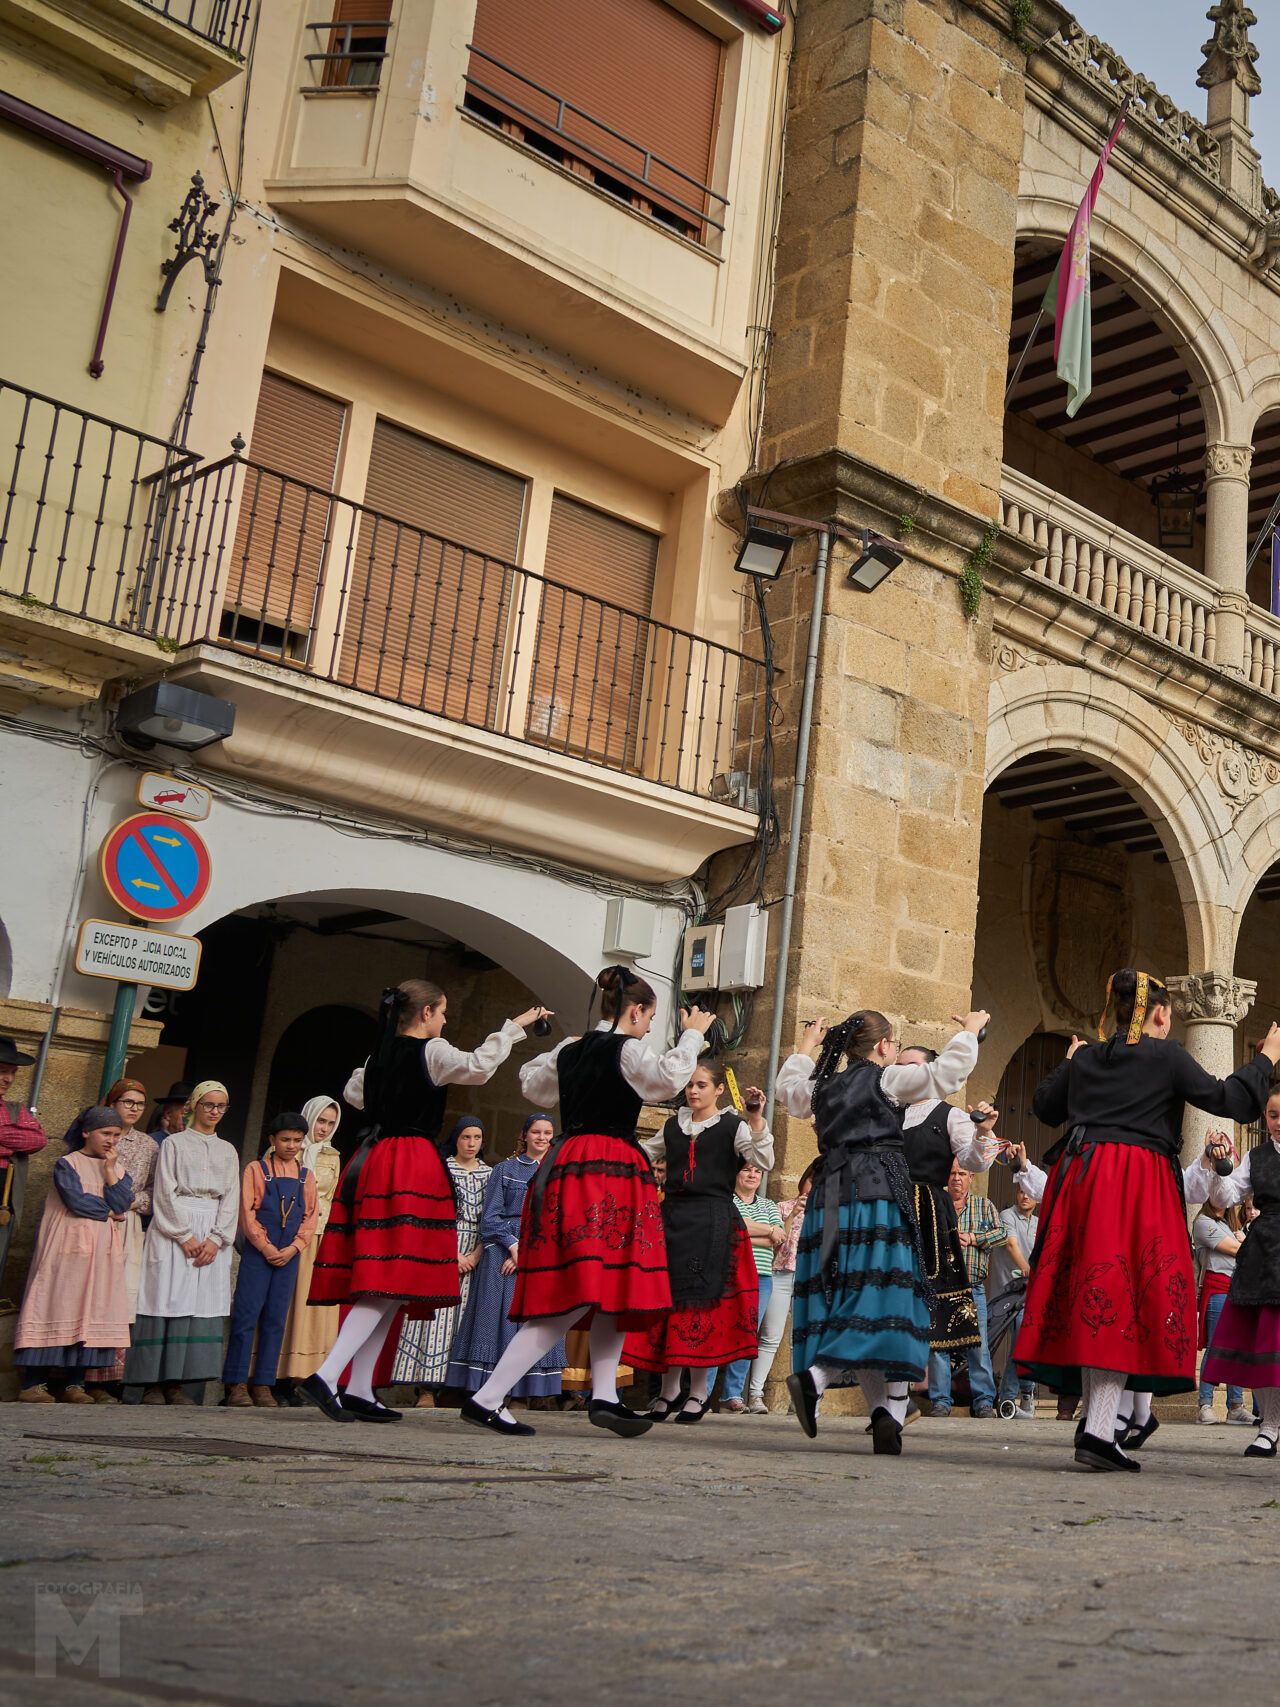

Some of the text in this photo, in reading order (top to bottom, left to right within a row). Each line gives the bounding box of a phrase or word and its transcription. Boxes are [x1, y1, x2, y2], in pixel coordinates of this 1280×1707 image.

[94, 932, 130, 949] EXCEPTO
[132, 938, 161, 955] PICIA
[84, 949, 191, 979] Y VEHÍCULOS AUTORIZADOS
